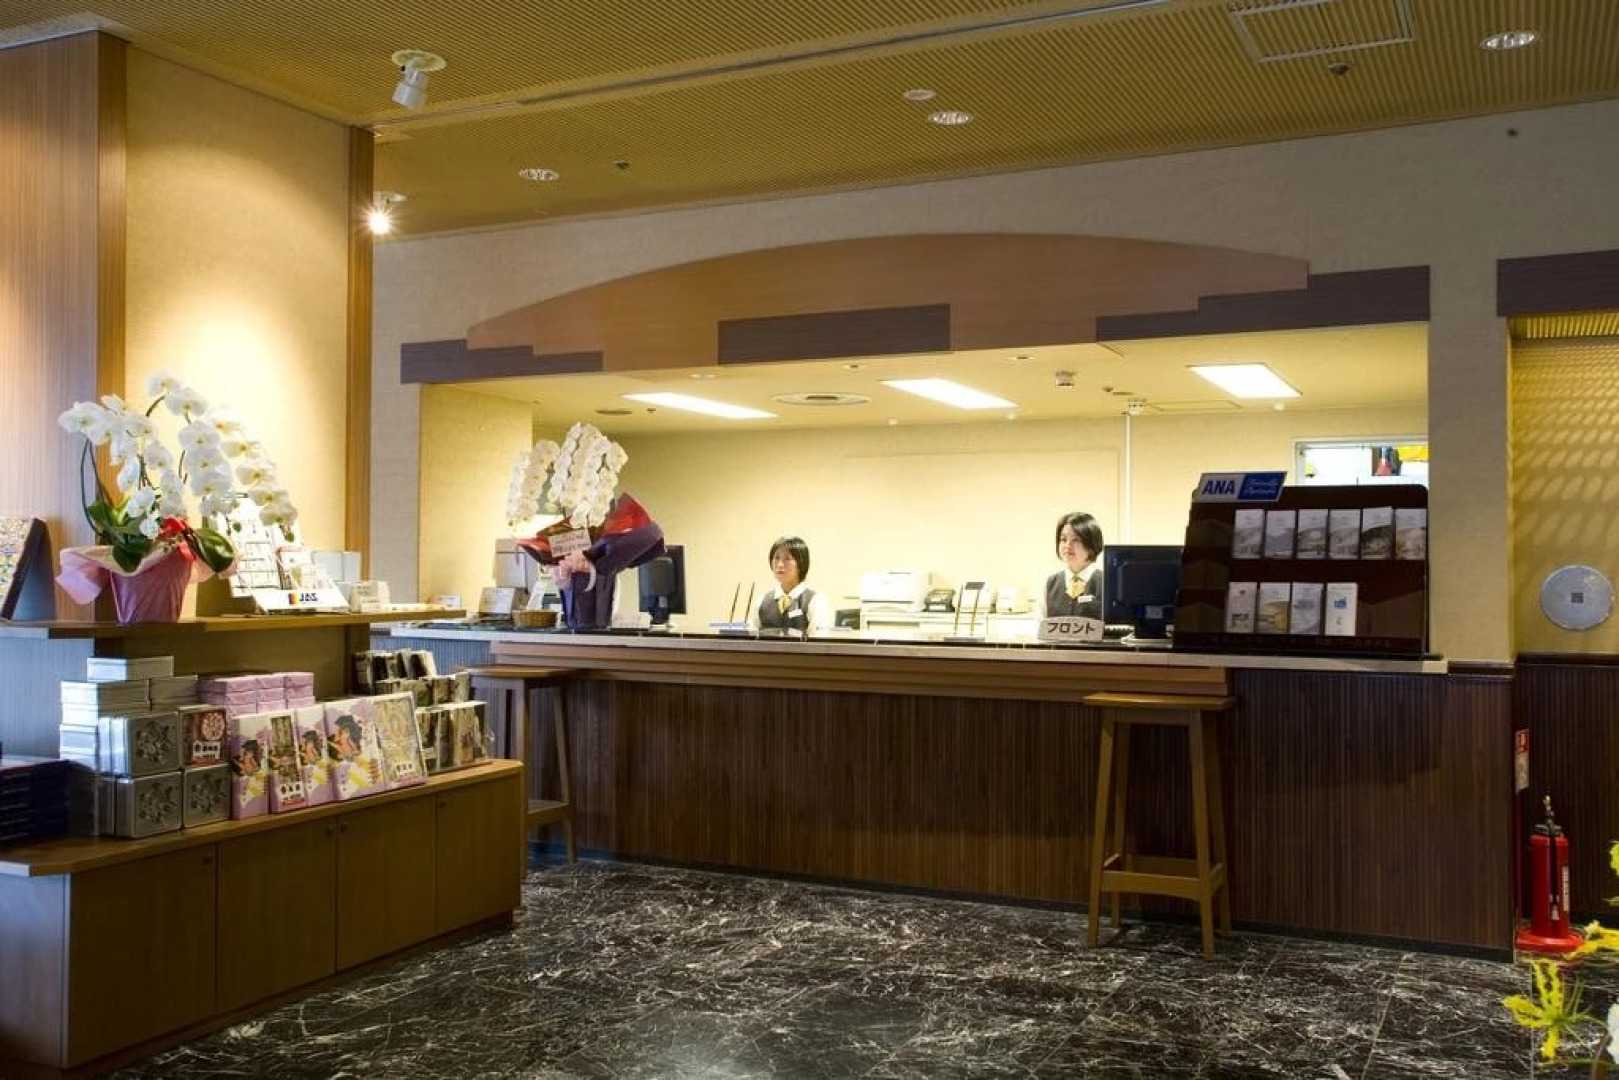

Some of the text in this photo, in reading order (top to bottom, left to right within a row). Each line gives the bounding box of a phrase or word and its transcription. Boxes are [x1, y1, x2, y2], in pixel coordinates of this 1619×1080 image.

[1202, 480, 1236, 495] ANA
[1048, 622, 1095, 634] フロント
